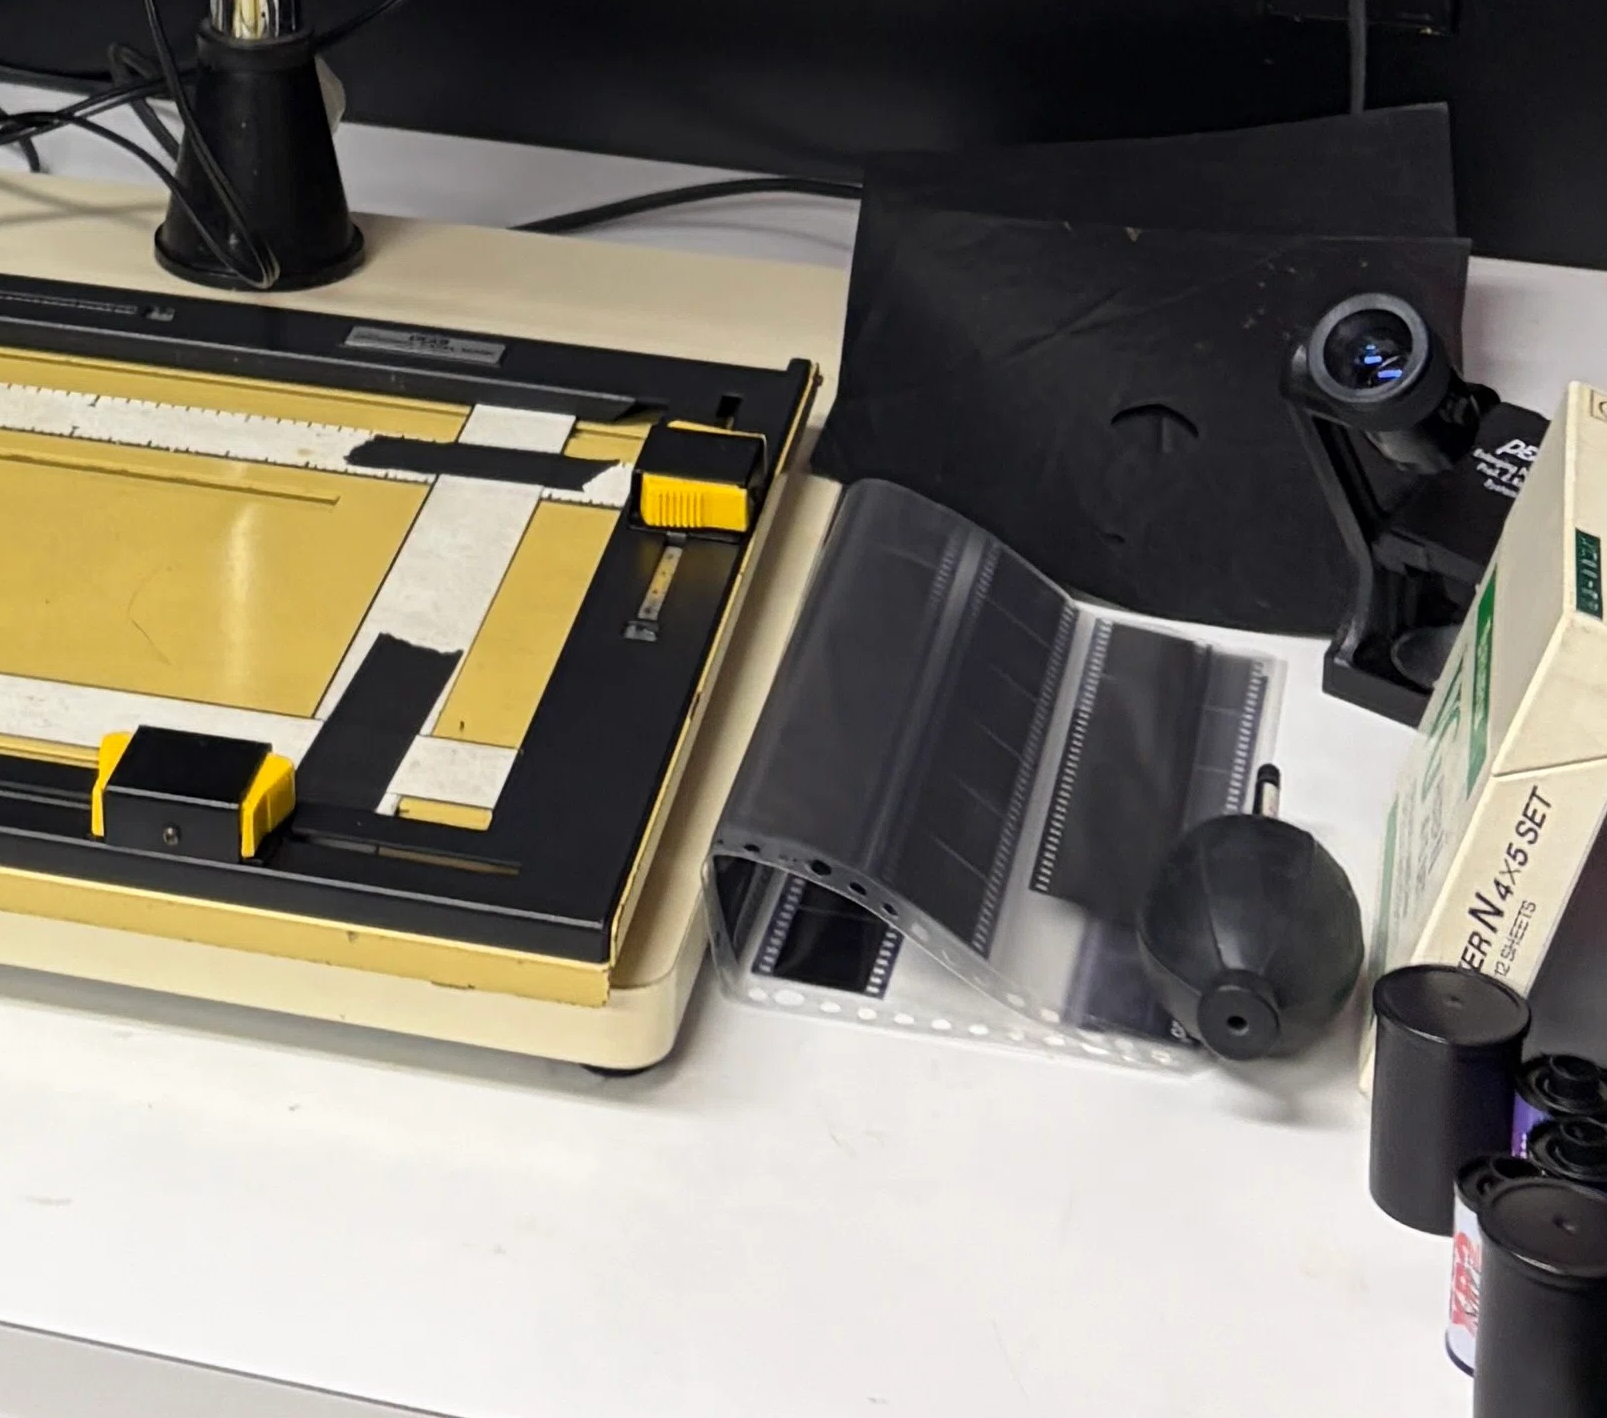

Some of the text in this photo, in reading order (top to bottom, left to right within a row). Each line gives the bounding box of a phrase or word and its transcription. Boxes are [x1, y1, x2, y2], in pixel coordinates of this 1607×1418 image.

[1515, 785, 1552, 845] SET
[1468, 891, 1504, 934] N
[1457, 930, 1492, 973] ER
[1494, 900, 1537, 977] 12 SHEETS
